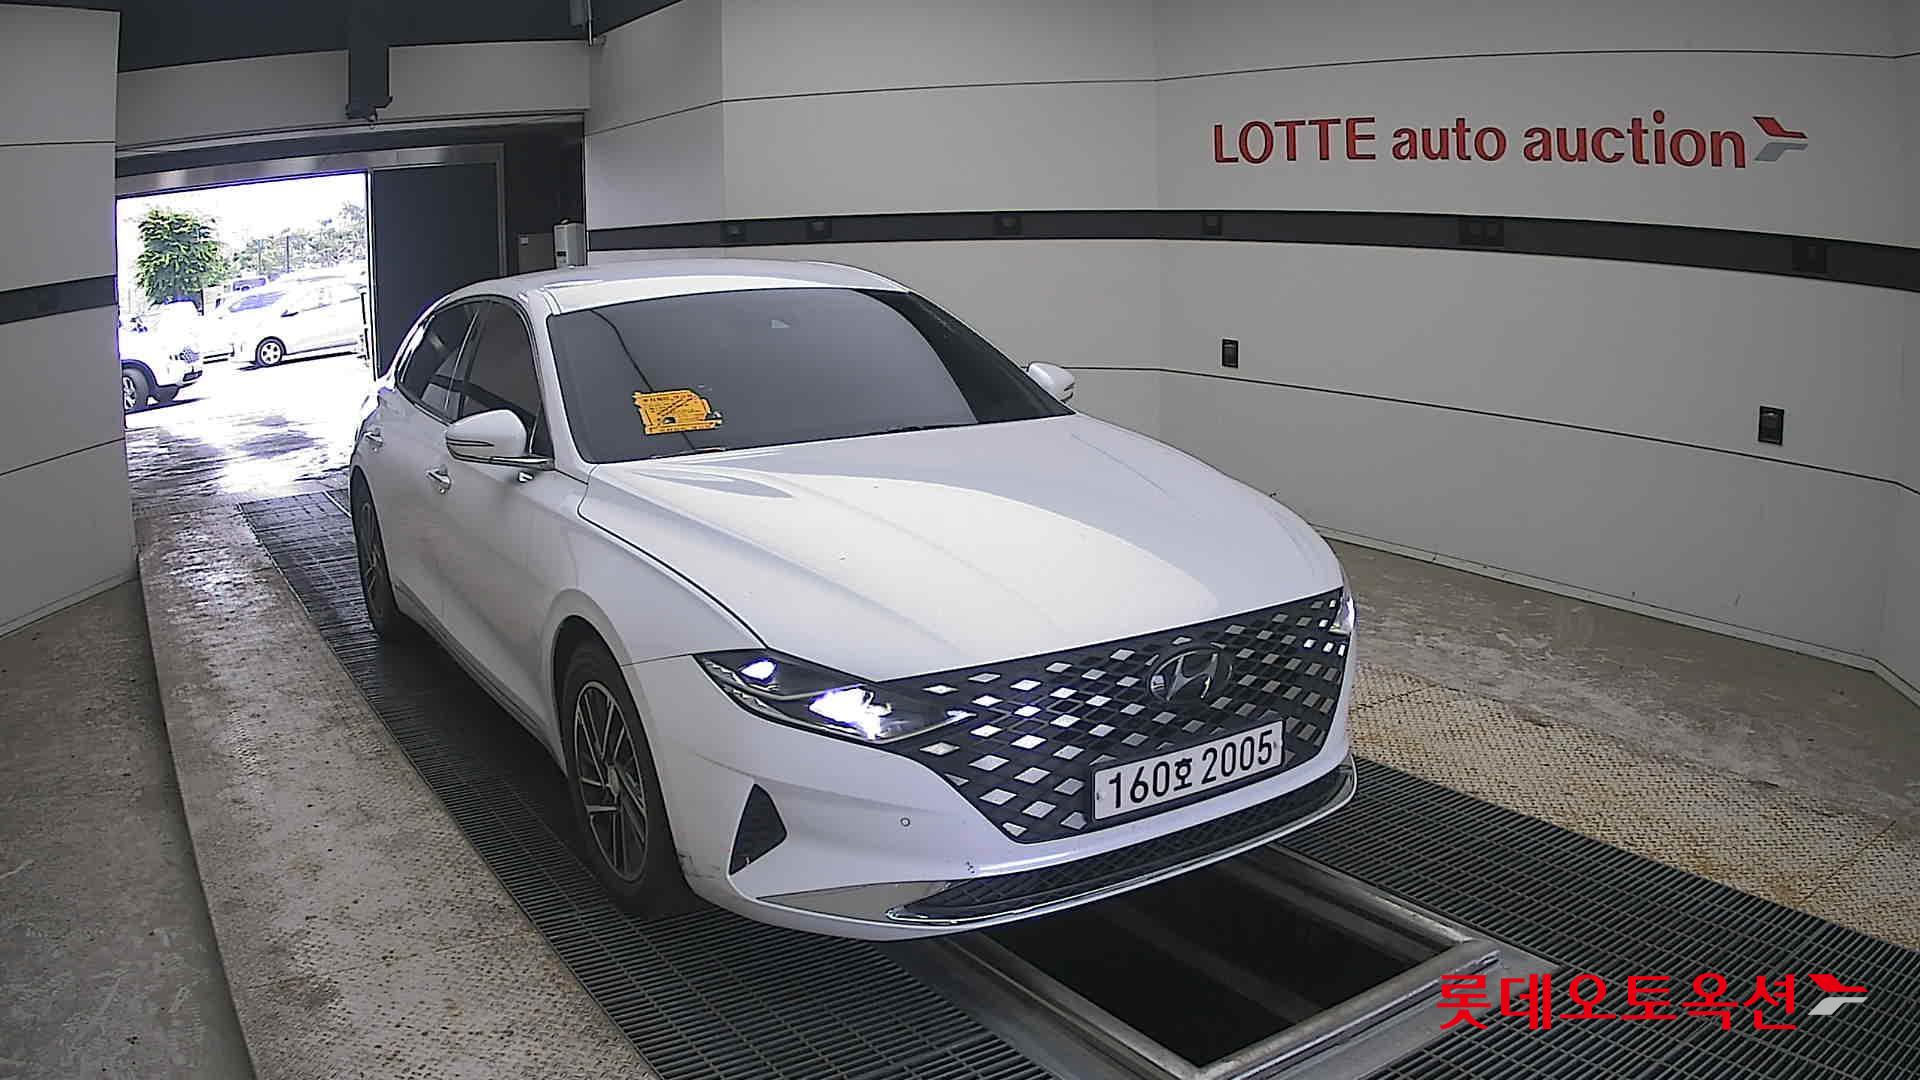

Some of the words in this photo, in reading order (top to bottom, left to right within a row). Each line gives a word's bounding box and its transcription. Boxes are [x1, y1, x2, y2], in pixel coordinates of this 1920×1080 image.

[1213, 116, 1376, 164] LOTTE
[1391, 117, 1507, 162] auto
[1522, 110, 1747, 168] auction
[1109, 757, 1193, 809] 160호
[1201, 729, 1273, 784] 2005
